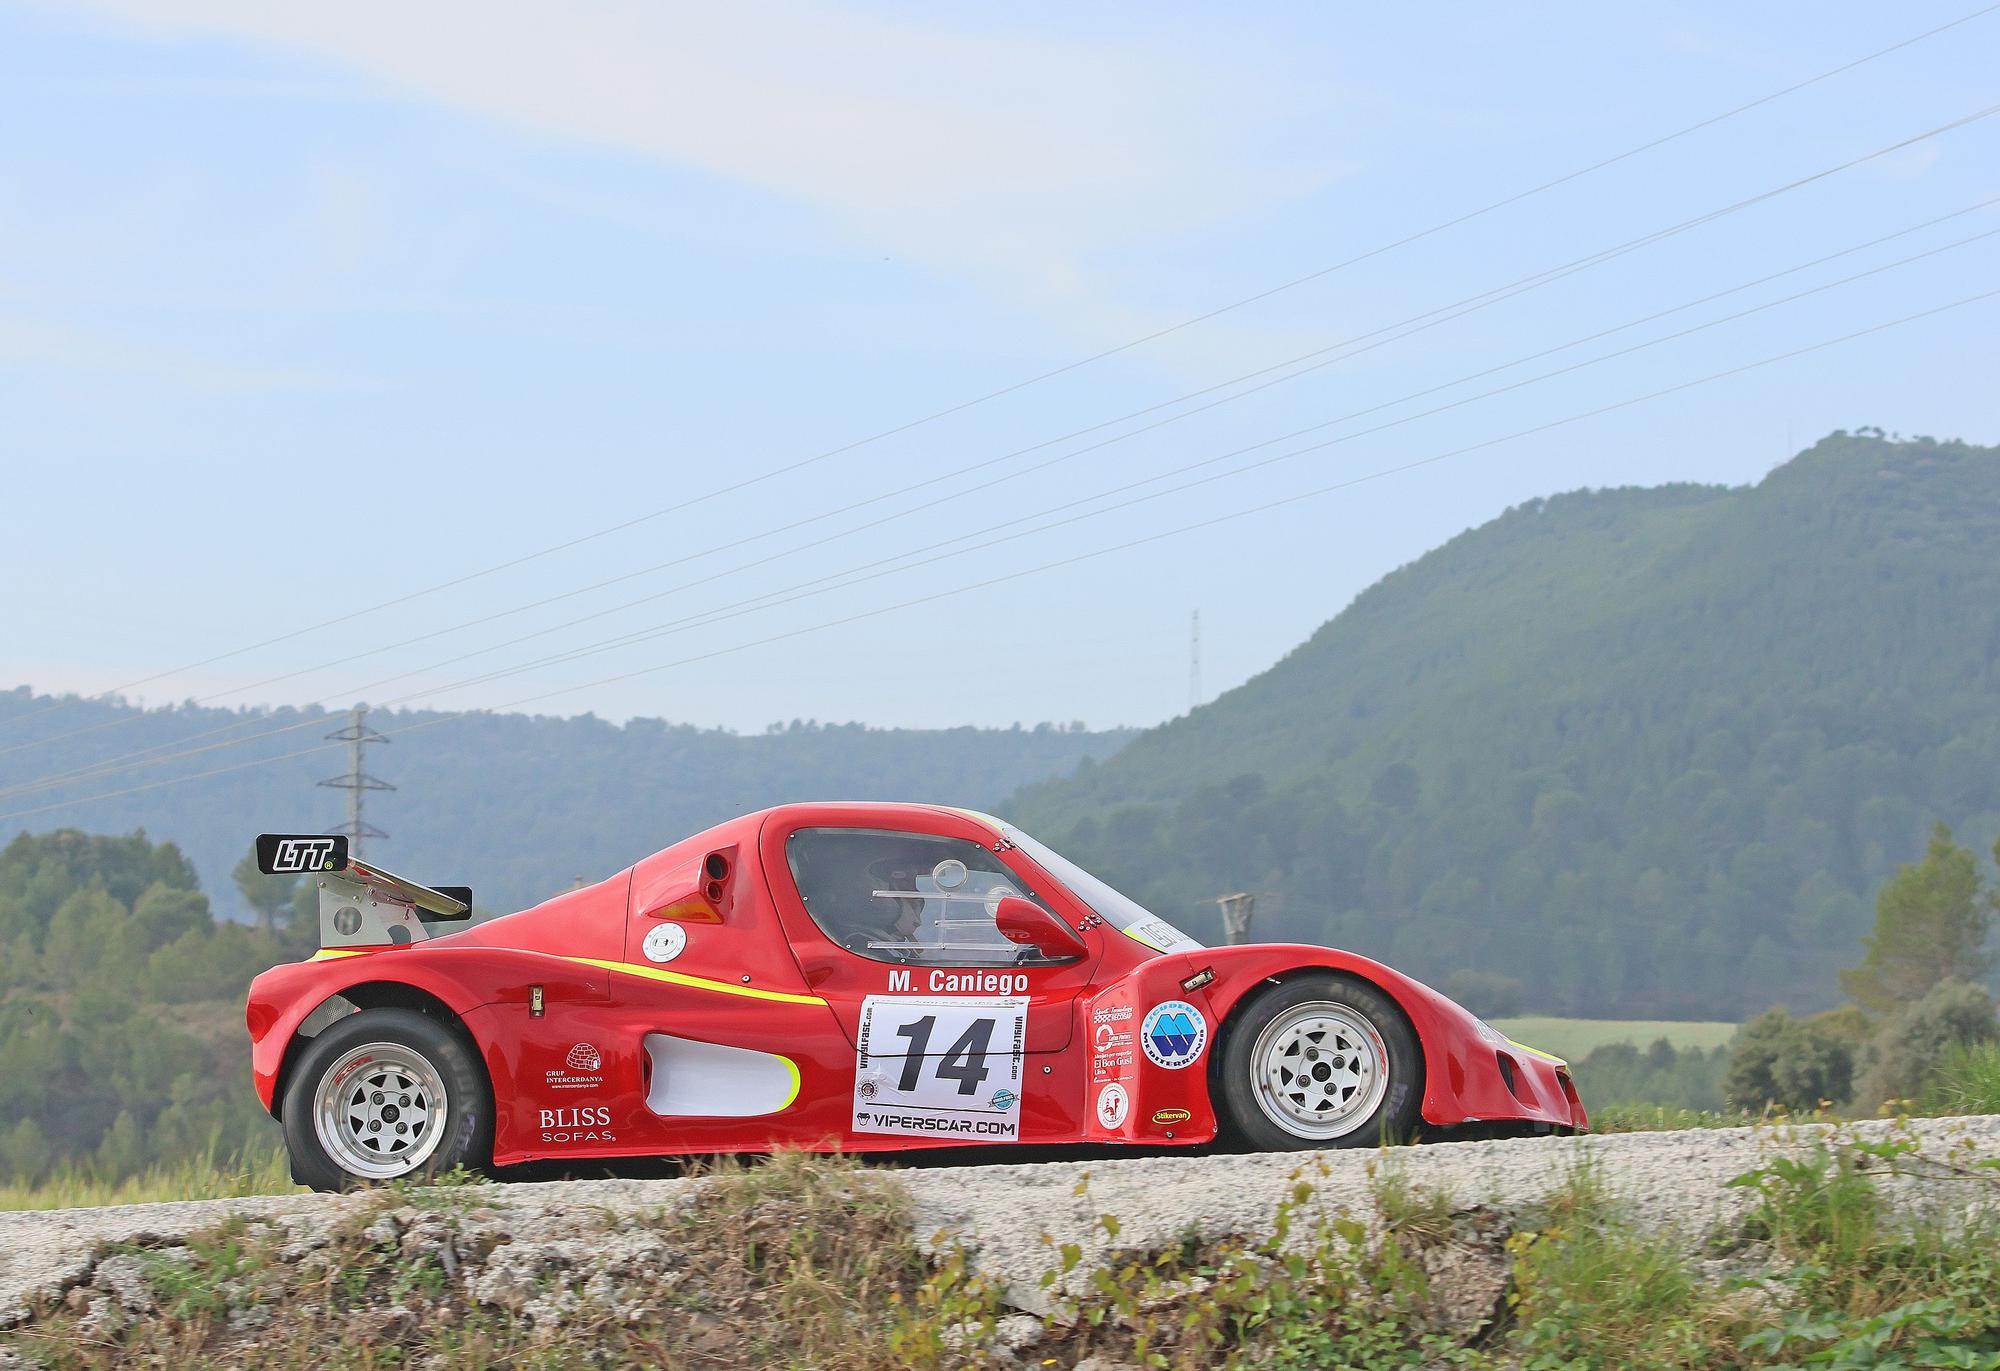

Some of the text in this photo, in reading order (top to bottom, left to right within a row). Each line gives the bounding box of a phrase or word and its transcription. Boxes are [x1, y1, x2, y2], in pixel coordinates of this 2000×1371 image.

[272, 839, 335, 871] LTT
[888, 970, 1028, 995] M. Caniego
[896, 1015, 996, 1096] 14
[539, 1107, 611, 1128] BLISS
[874, 1114, 1015, 1135] VIPERSCAR.COM
[1156, 1112, 1187, 1120] Stikervan
